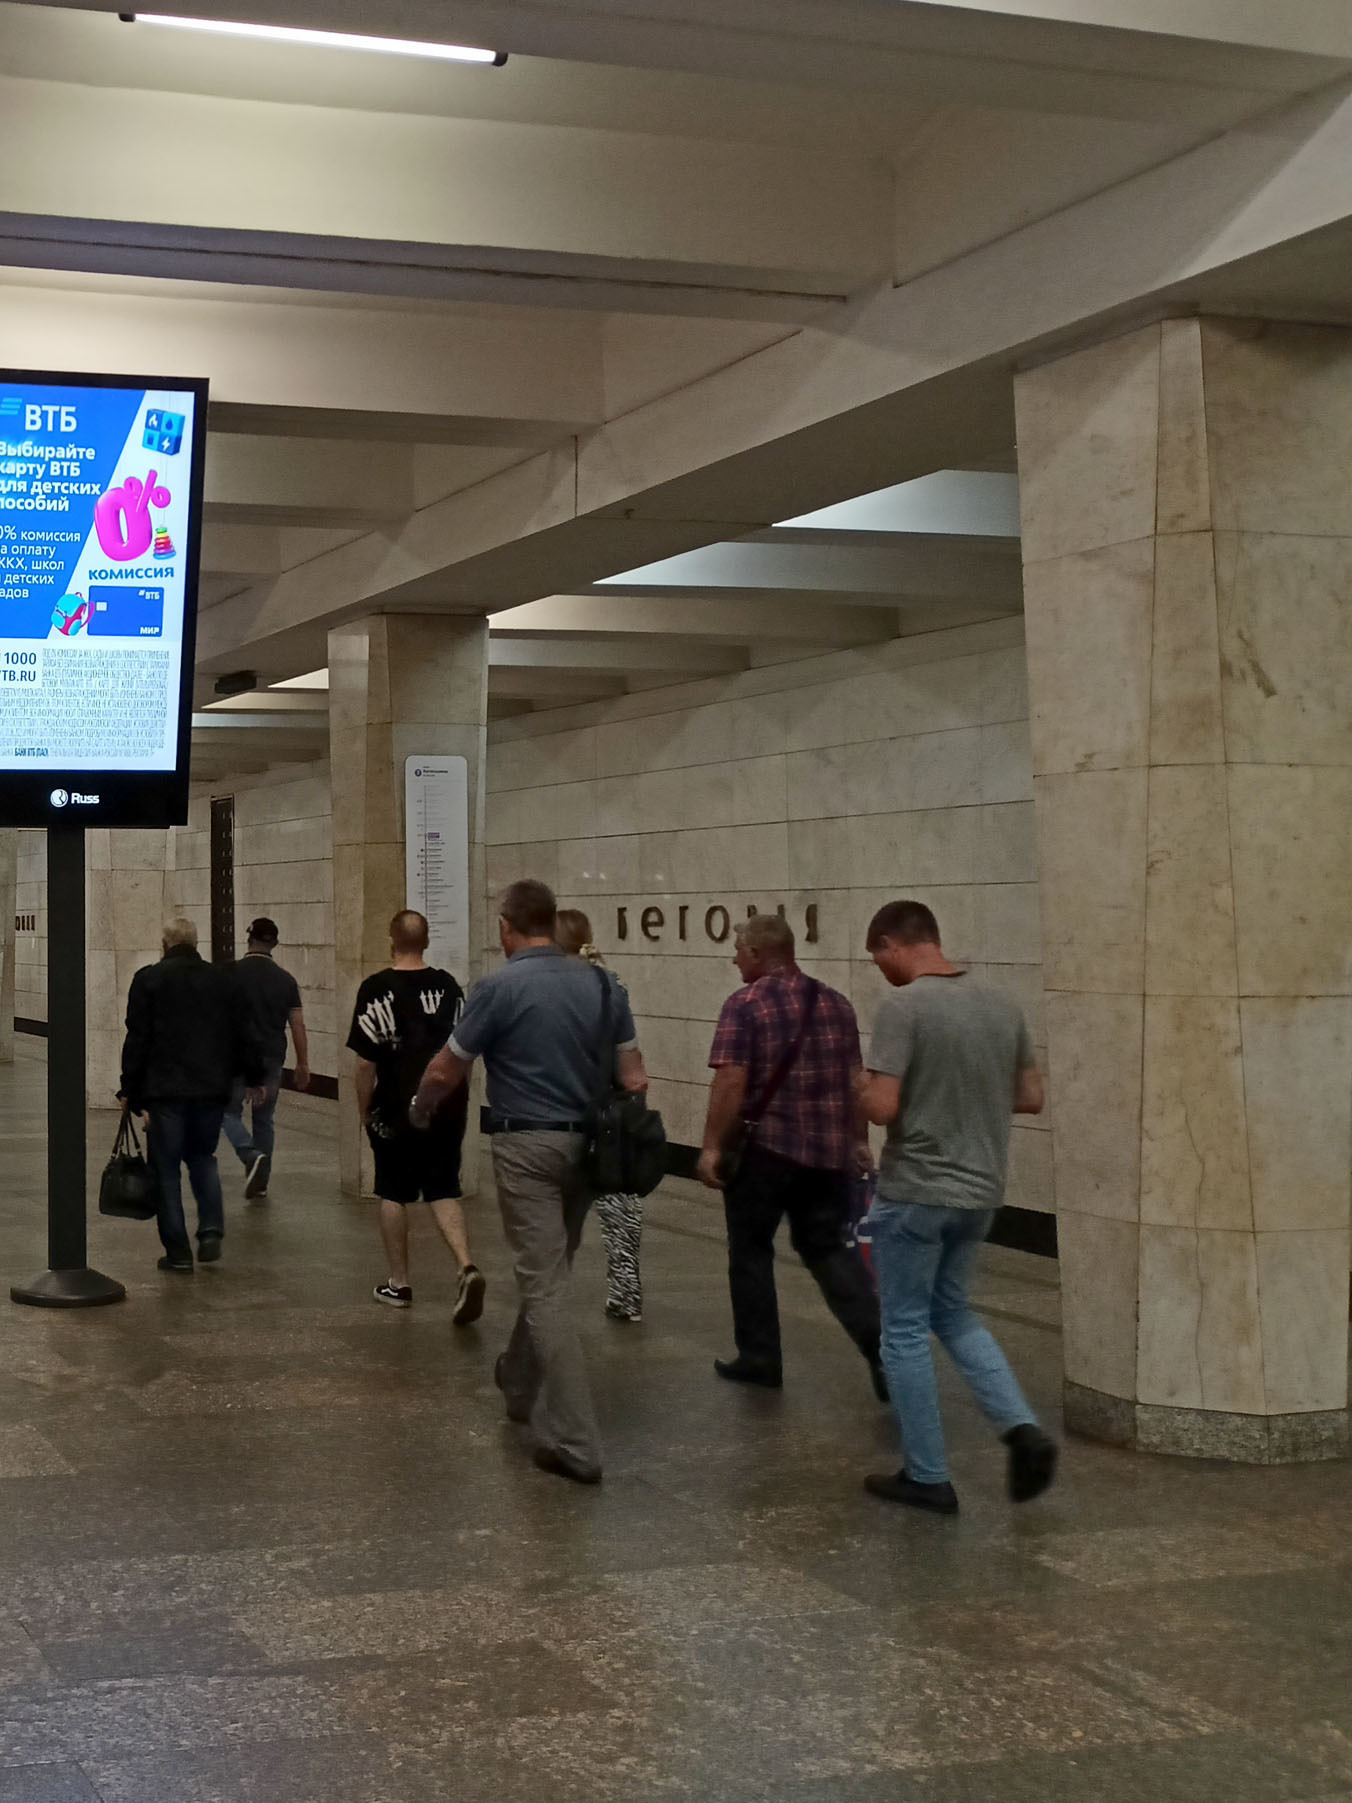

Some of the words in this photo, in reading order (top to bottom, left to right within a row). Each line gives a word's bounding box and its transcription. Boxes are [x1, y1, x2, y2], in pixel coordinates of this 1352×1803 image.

[25, 404, 77, 432] ВТБ
[50, 461, 80, 477] ВТБ
[31, 481, 101, 496] детских
[20, 530, 81, 542] комиссия
[11, 545, 56, 558] оплату
[31, 560, 64, 570] школ
[4, 574, 54, 585] детских
[140, 627, 160, 635] МИР
[4, 652, 37, 665] 1000
[71, 792, 100, 804] Russ
